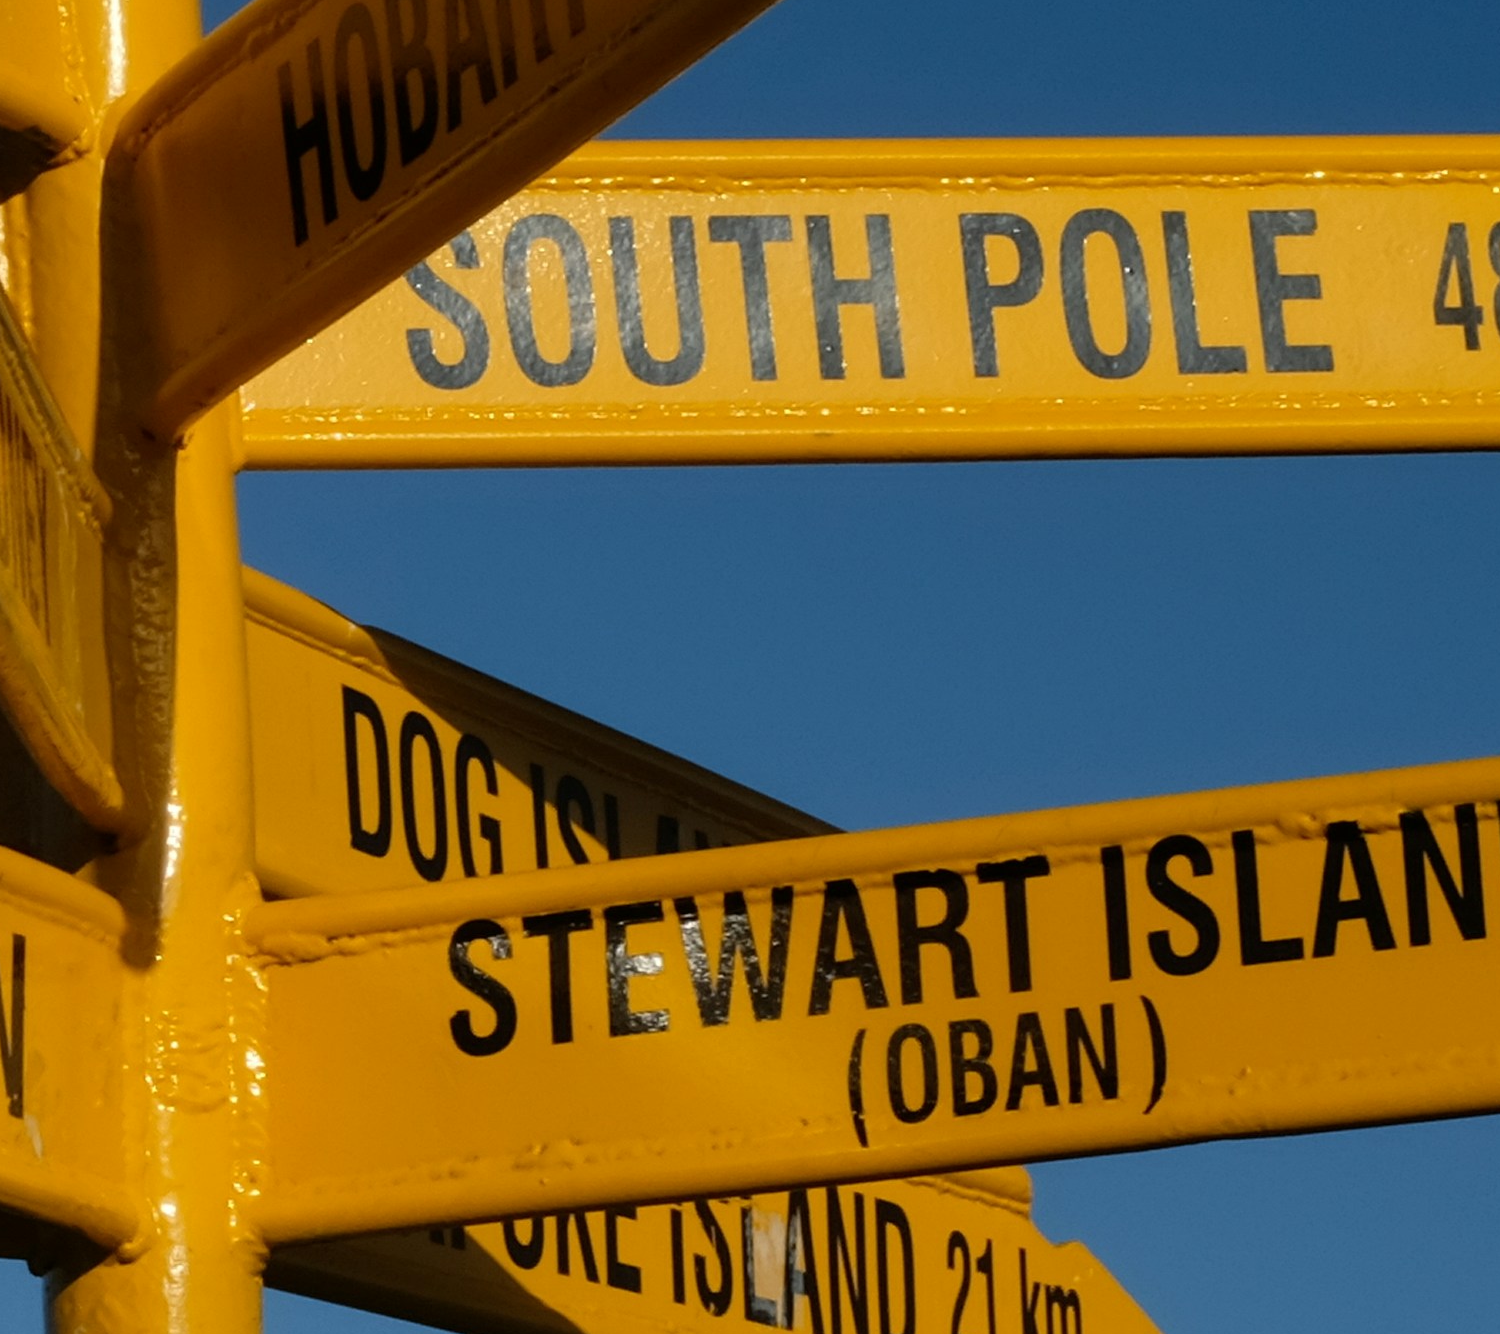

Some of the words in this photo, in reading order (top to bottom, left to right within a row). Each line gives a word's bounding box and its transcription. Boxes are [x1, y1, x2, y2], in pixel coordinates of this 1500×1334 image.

[404, 211, 909, 391] SOUTH
[957, 208, 1336, 383] POLE
[341, 683, 503, 883] DOG
[447, 857, 1054, 1058] STEWART
[845, 1001, 1170, 1148] (OBAN)
